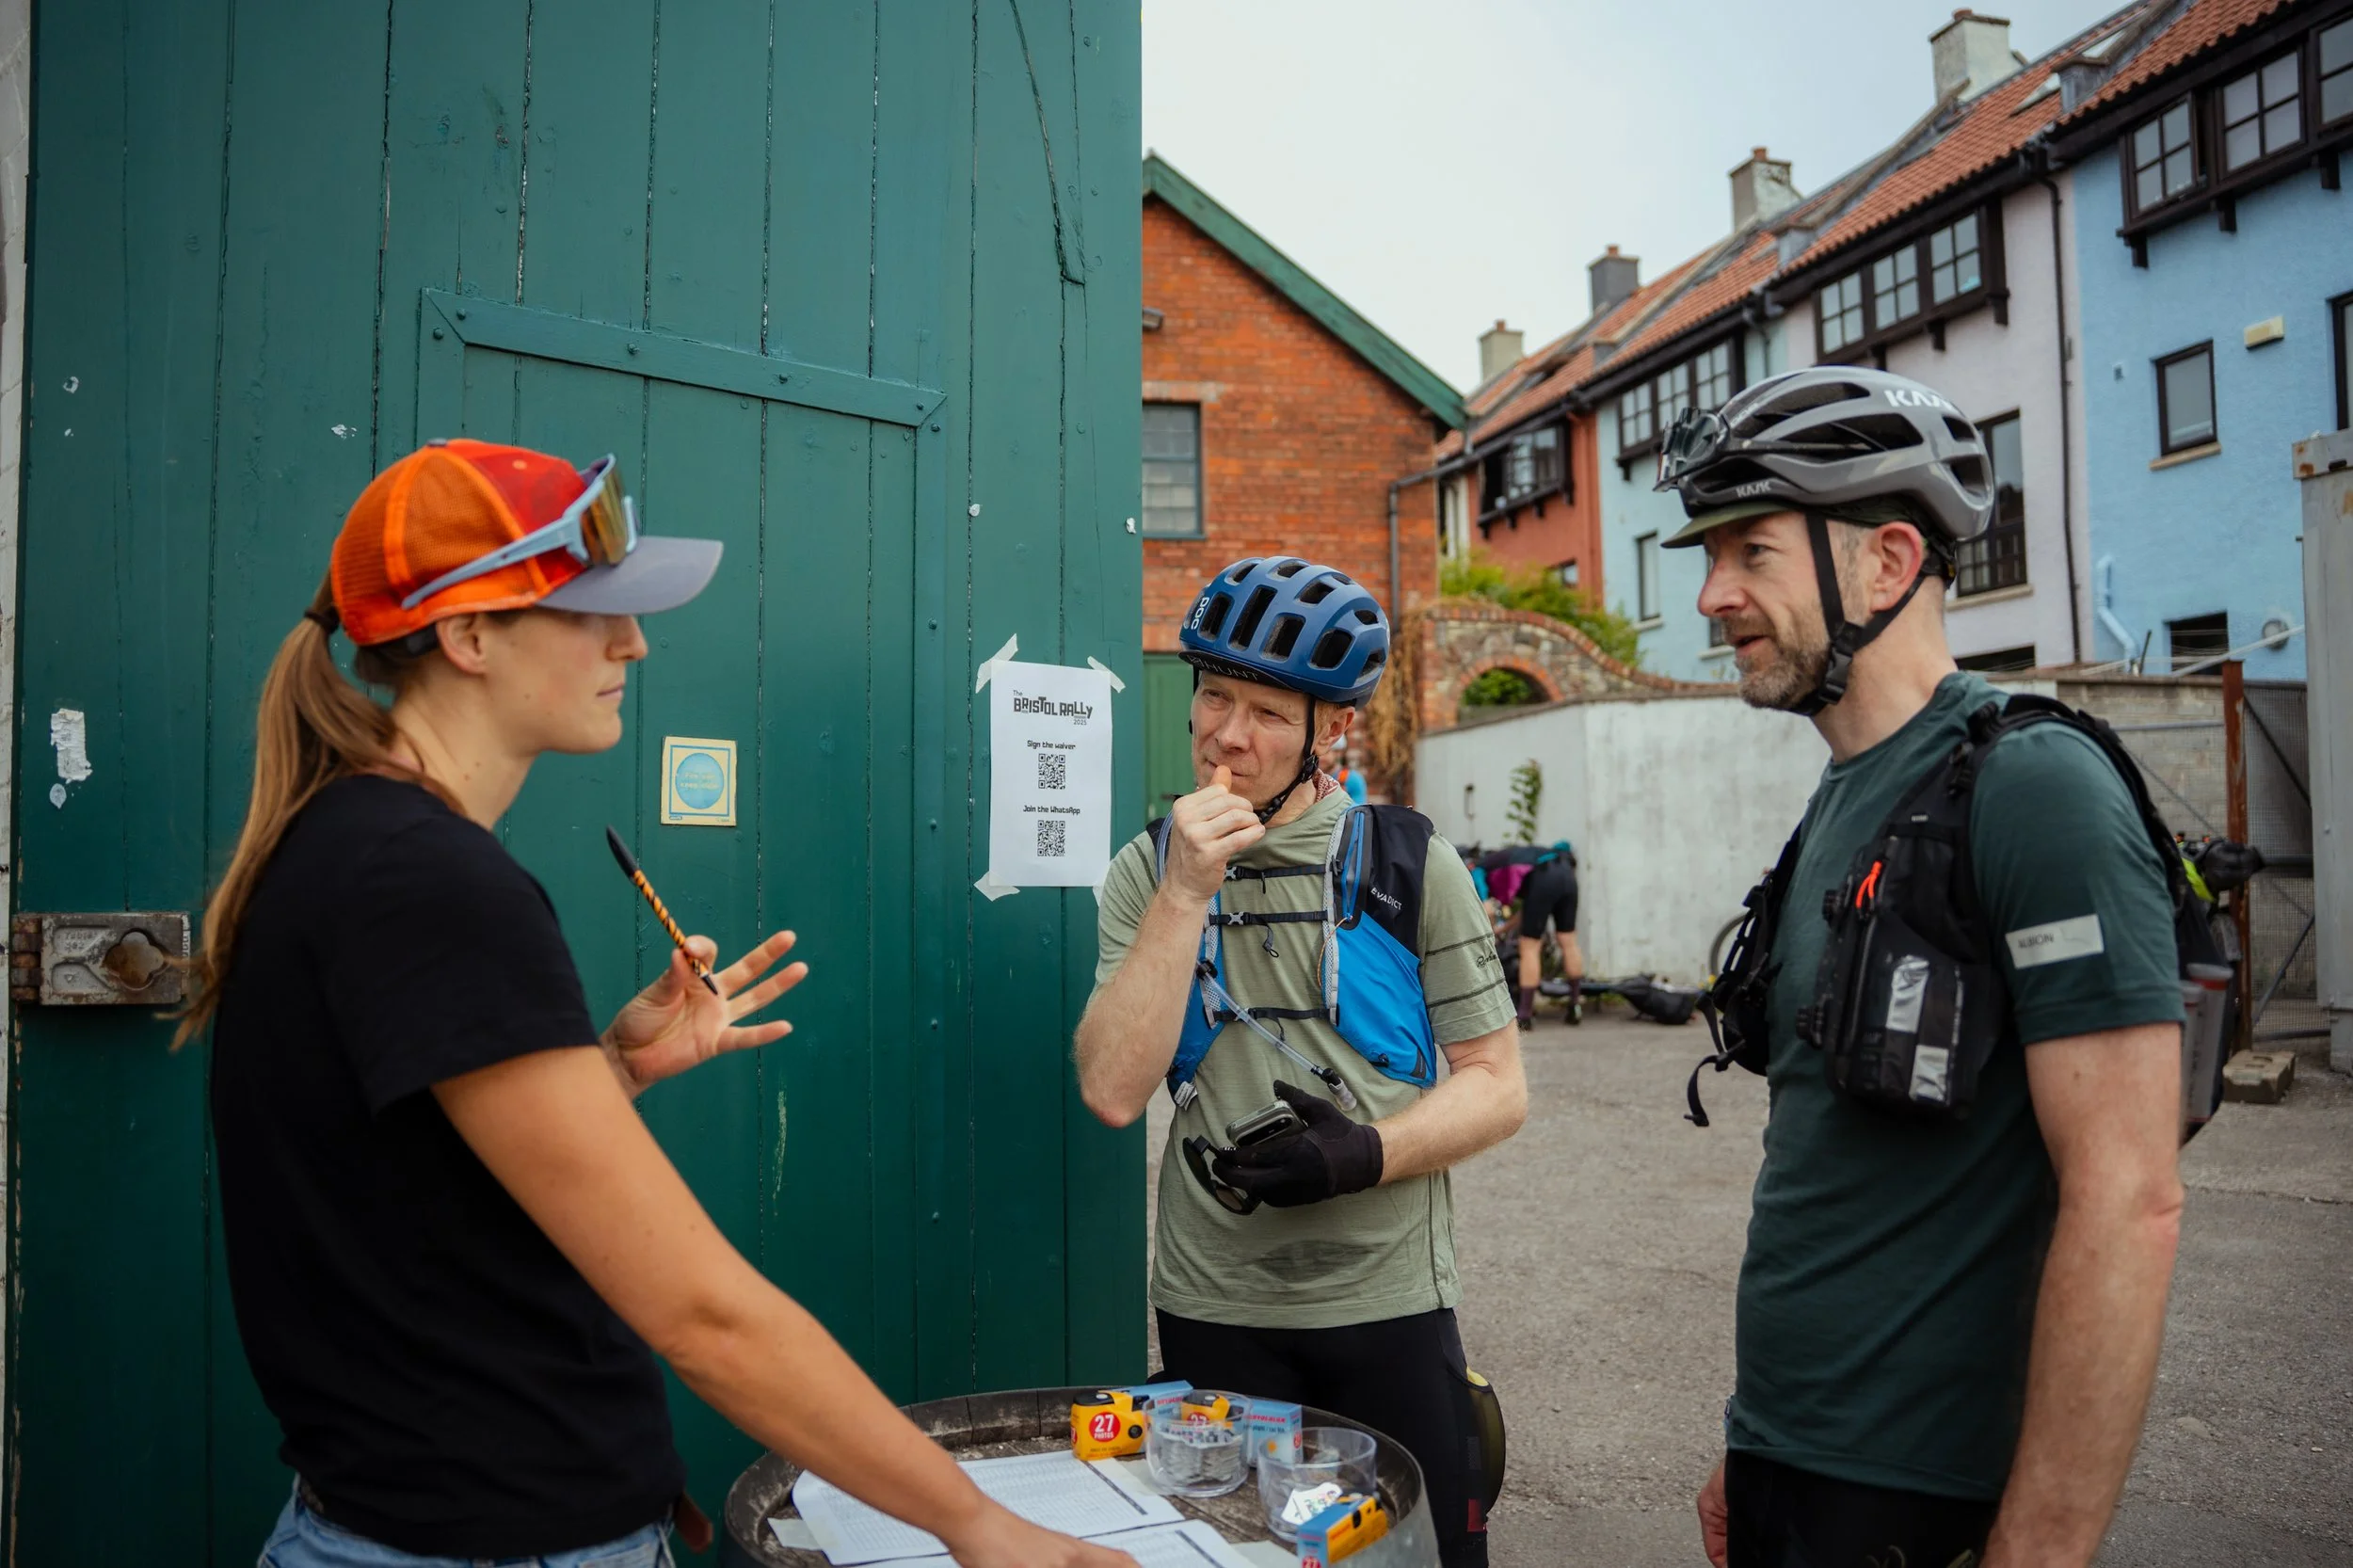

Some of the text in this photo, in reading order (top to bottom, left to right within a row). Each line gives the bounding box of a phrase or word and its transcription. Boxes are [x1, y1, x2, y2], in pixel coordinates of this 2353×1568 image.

[1736, 481, 1771, 498] KASK
[1014, 696, 1058, 715] BRISTOL
[1027, 740, 1041, 749] Sign
[1054, 742, 1076, 750] waiver
[1049, 806, 1080, 816] WhatsApp
[1370, 887, 1402, 911] EVADICT
[2018, 934, 2055, 949] ALBION
[1095, 1414, 1114, 1432] 27
[1094, 1432, 1114, 1440] PHOTOS
